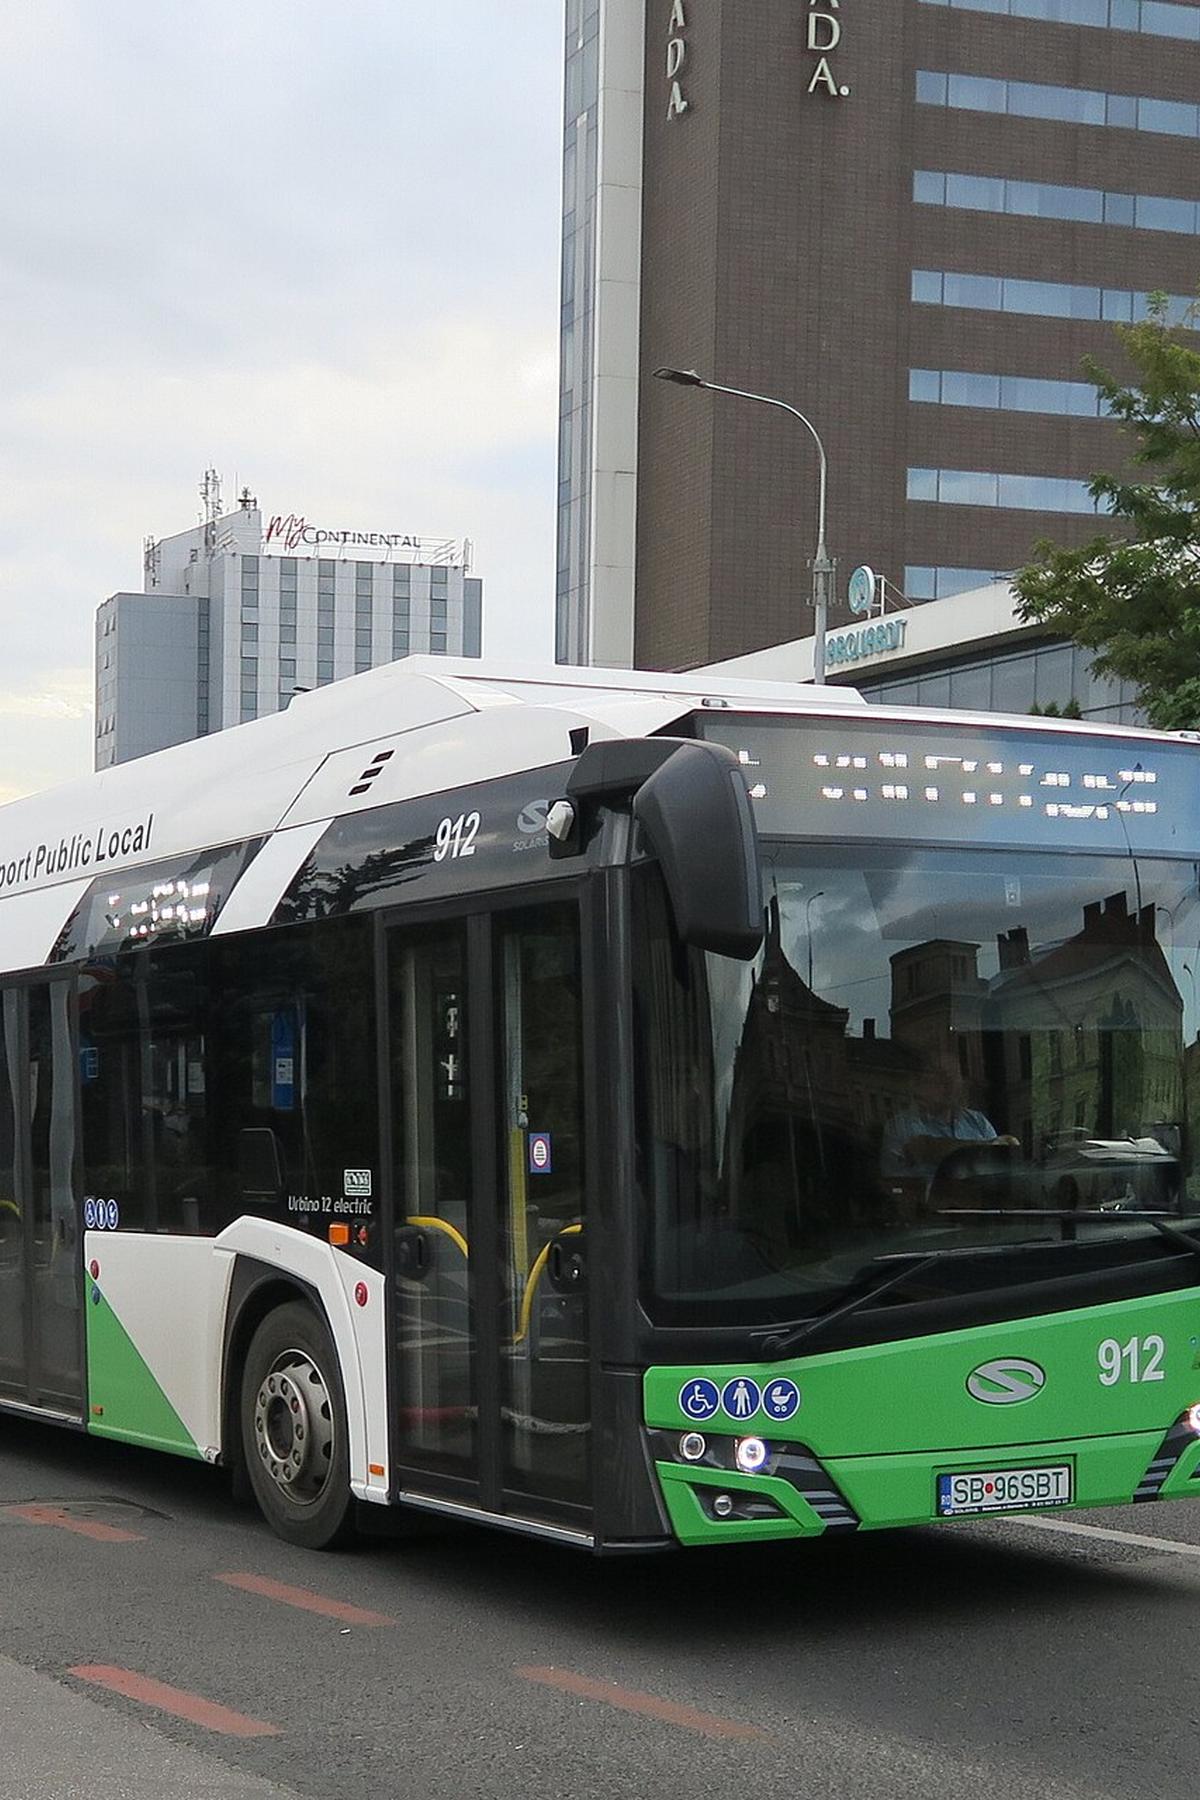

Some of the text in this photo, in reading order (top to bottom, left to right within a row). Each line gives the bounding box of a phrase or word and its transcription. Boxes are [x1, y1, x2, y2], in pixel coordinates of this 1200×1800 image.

[807, 0, 850, 97] DA.
[266, 513, 308, 551] My
[33, 833, 92, 878] Public
[95, 813, 154, 863] Local
[434, 811, 481, 862] 912
[288, 1195, 373, 1215] Urbino 12 electric
[1098, 1334, 1165, 1386] 912
[954, 1472, 1064, 1504] SB 96SBT
